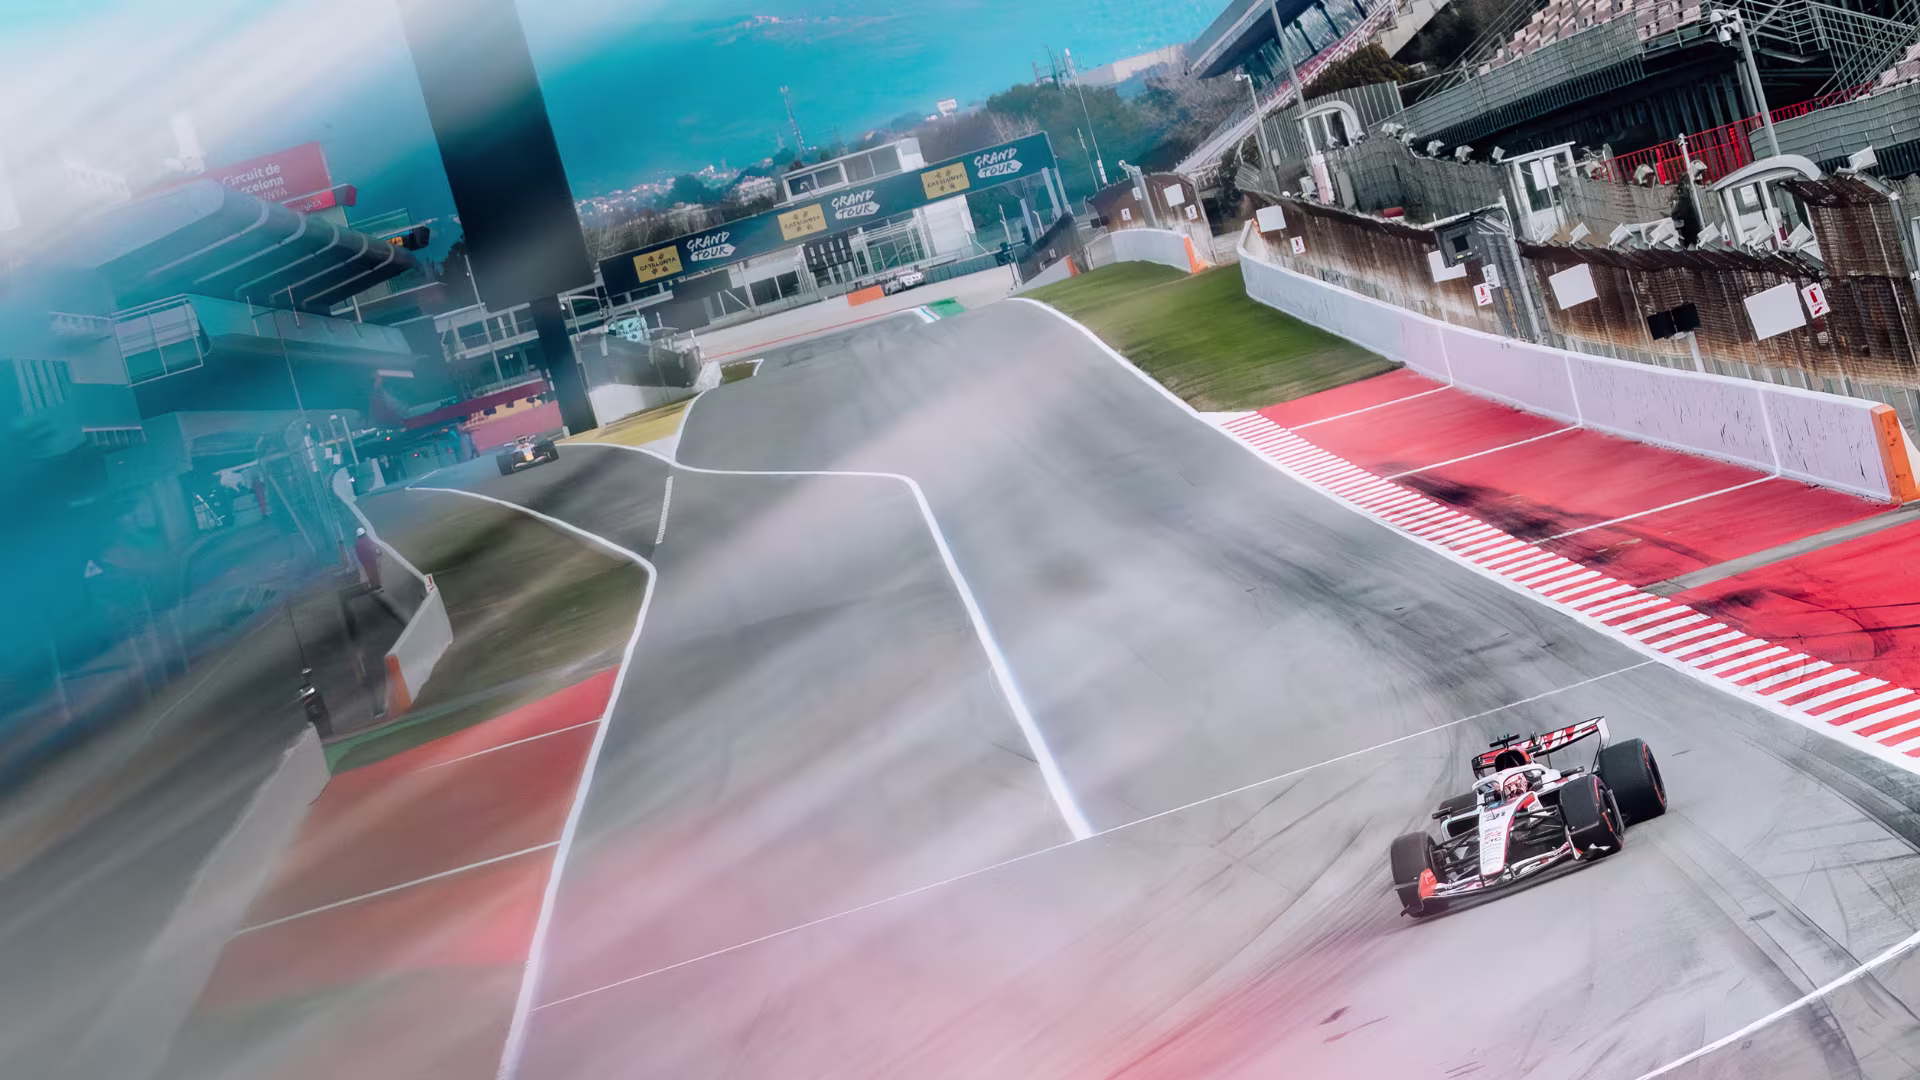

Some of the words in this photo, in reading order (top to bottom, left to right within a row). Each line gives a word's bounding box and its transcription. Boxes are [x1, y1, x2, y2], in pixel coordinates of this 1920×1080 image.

[974, 148, 1017, 168] GRAND
[222, 166, 264, 187] Circuit
[266, 164, 281, 176] de
[982, 163, 1016, 177] TOUR
[832, 189, 875, 210] GRAND
[840, 204, 873, 218] TOUR
[687, 231, 730, 252] GRAND
[693, 246, 729, 260] TOUR
[640, 256, 676, 271] CATALUNYA
